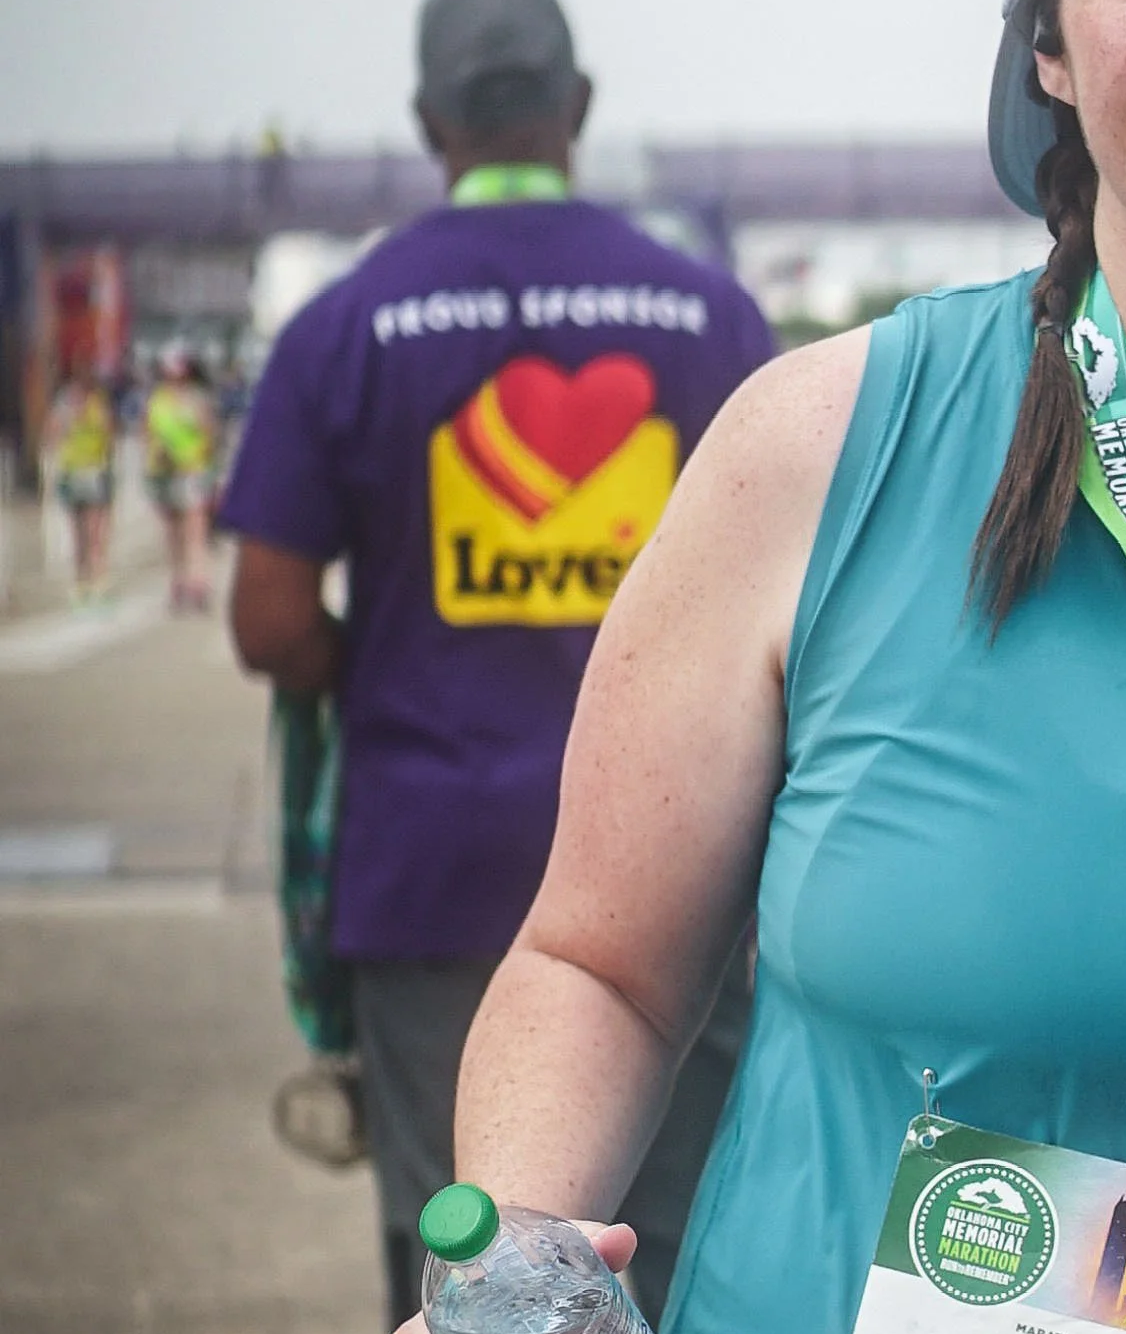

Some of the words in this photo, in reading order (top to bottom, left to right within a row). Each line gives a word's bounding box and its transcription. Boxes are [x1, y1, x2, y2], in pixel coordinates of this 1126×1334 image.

[372, 290, 510, 346] PROUD
[520, 286, 707, 336] SPONSOR
[942, 1218, 1023, 1255] MEMORIAL
[947, 1206, 1001, 1230] OKLAHOMA
[1004, 1221, 1029, 1237] CITY
[938, 1236, 1020, 1273] MARATHON
